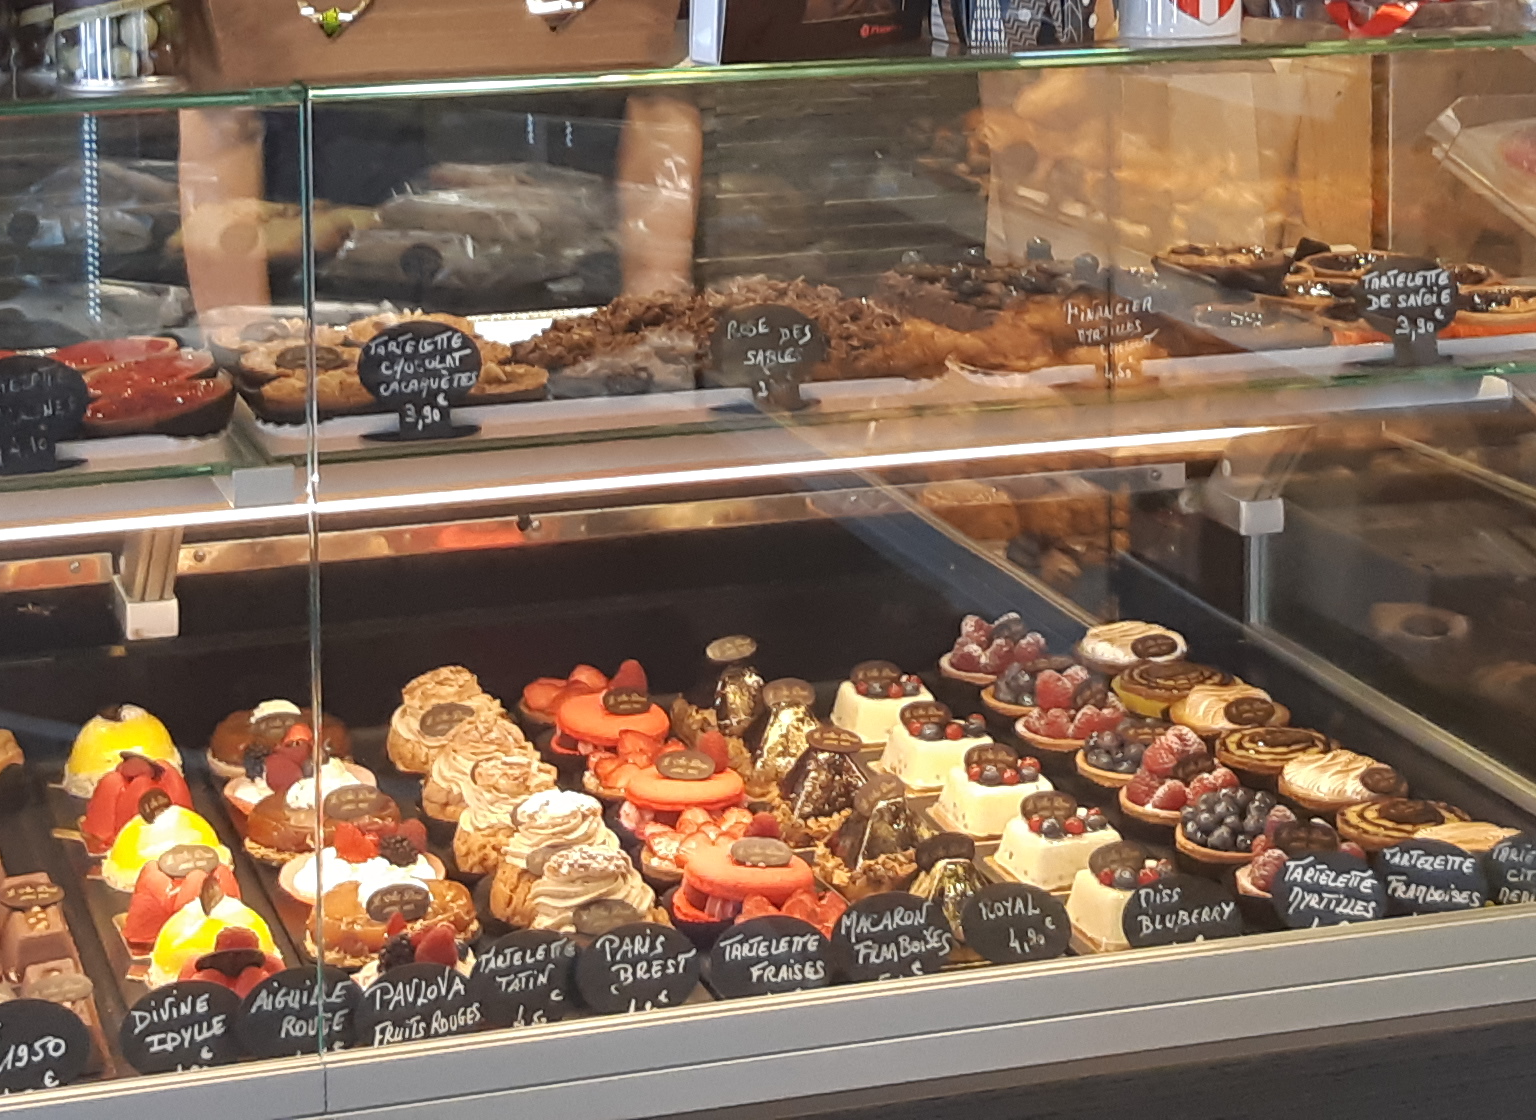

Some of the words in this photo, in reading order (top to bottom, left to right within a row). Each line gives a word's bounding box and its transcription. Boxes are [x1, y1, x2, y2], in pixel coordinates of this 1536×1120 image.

[1362, 268, 1449, 291] TARTELETTE
[1366, 293, 1391, 311] DE
[1397, 286, 1451, 308] SAVOIE
[368, 331, 462, 356] TARTELETTE
[1284, 856, 1378, 893] TARTELETTE
[1383, 847, 1476, 875] TARTELETTE
[979, 893, 1040, 921] ROYAL
[1137, 901, 1235, 935] BLUBERRY
[1288, 886, 1377, 918] MYRTILLES
[840, 901, 934, 943] MACARON
[478, 938, 576, 974] TARTELETTE
[596, 929, 666, 961] PARIS
[720, 934, 820, 962] TARTELETTE
[495, 963, 556, 992] TATIN
[611, 948, 697, 985] BREST
[750, 958, 825, 983] FRAISES
[364, 966, 465, 1012] PAVLOVA
[131, 990, 210, 1035] DIVINE
[374, 1016, 426, 1048] FRUITS
[431, 1002, 481, 1036] ROUGES
[144, 1014, 226, 1053] IDYLLE
